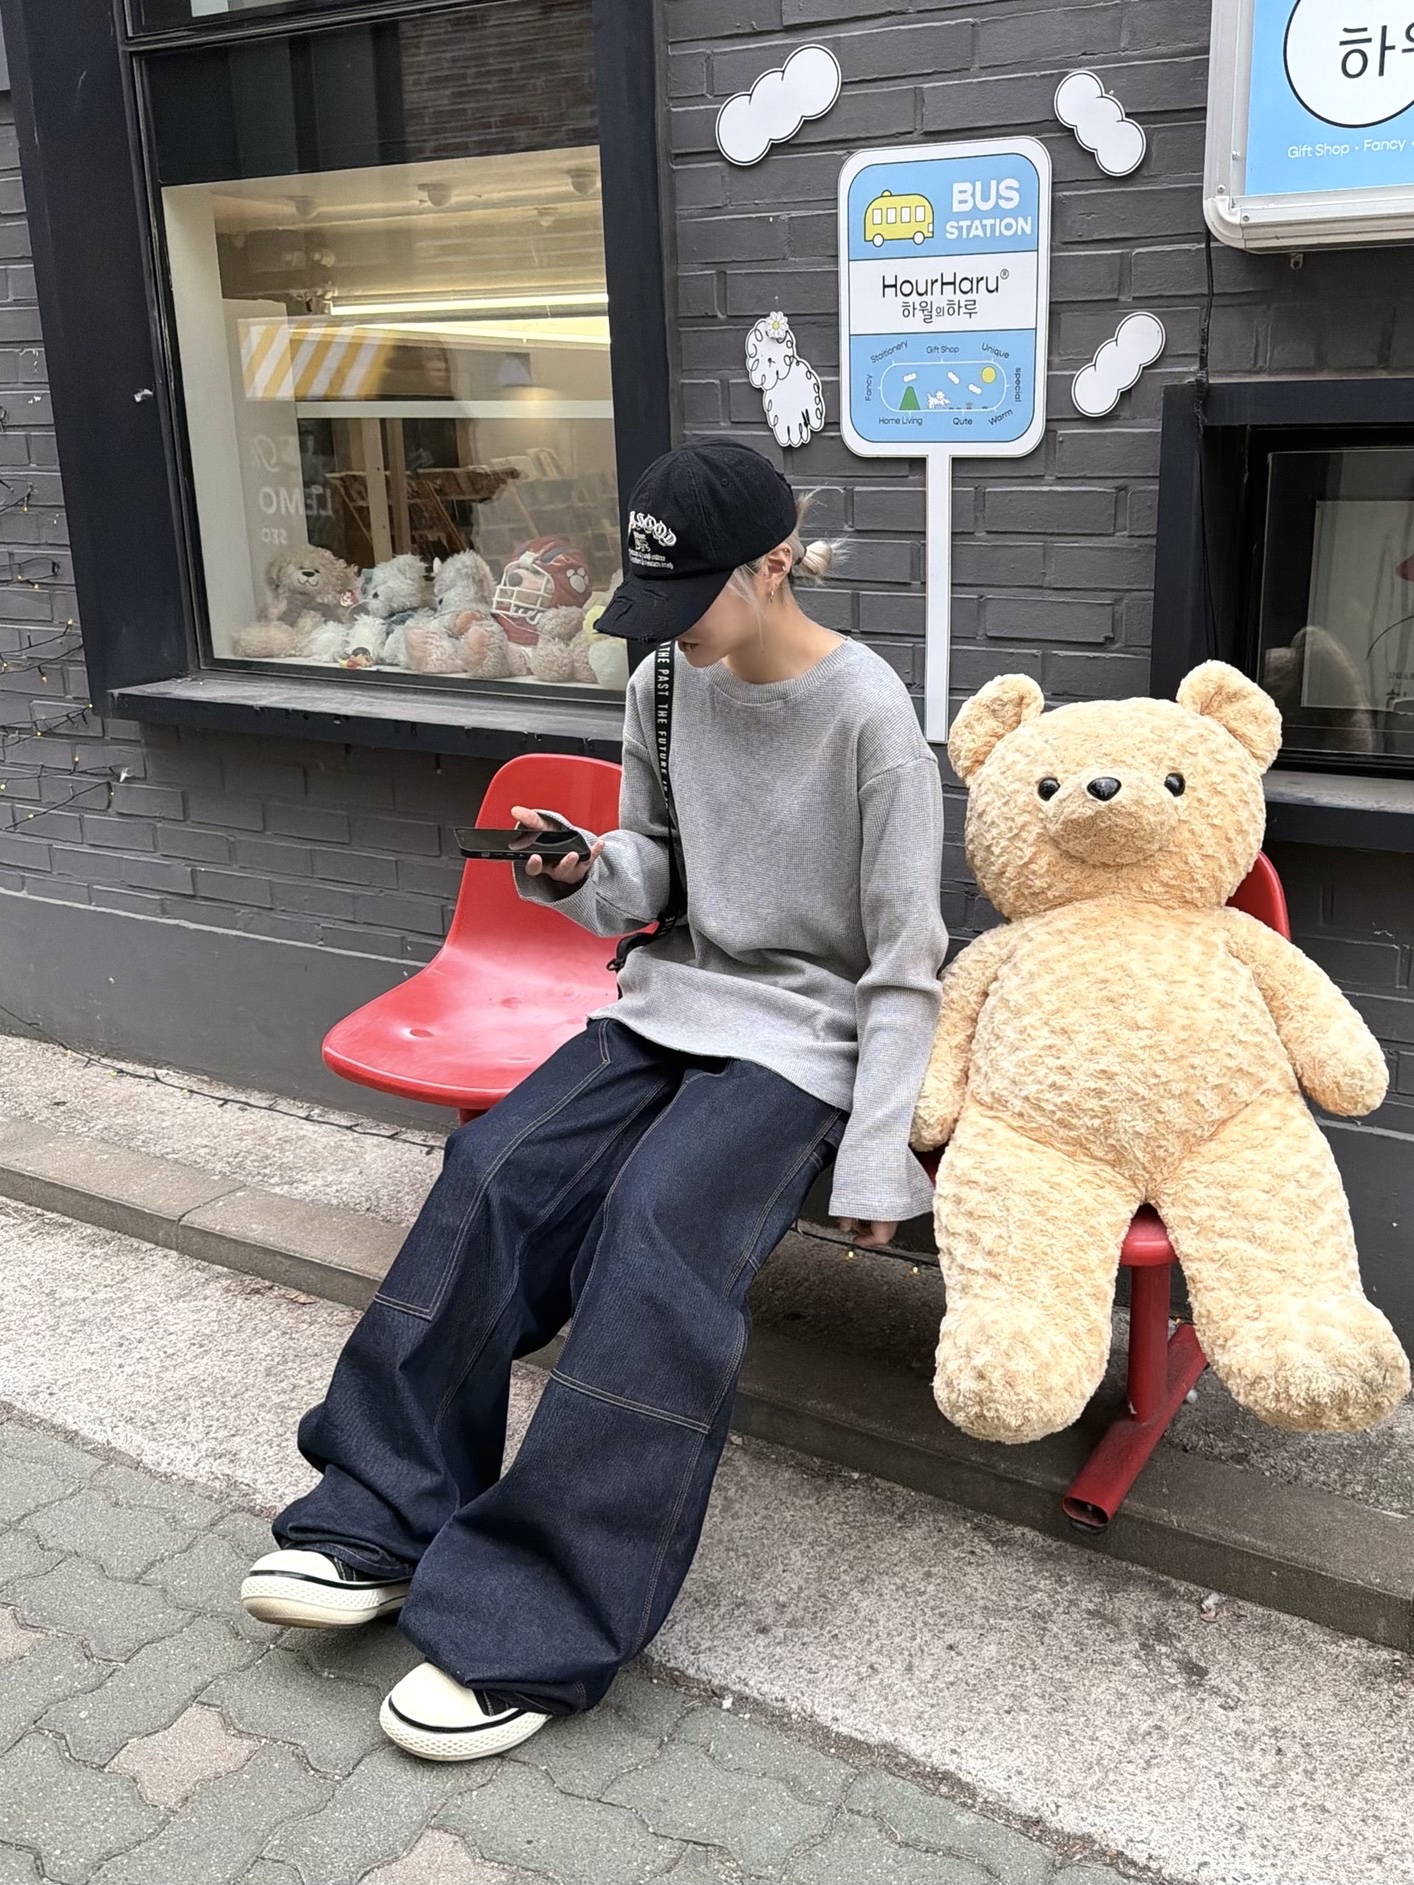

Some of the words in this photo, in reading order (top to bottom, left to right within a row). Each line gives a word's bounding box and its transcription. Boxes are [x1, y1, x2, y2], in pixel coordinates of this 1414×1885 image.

[1287, 143, 1312, 159] Gift
[1315, 142, 1349, 158] Shop
[1363, 137, 1405, 153] Fancy
[952, 177, 1020, 213] BUS
[945, 216, 1031, 240] STATION
[926, 345, 939, 354] Gift
[940, 345, 960, 354] Shop
[981, 342, 1010, 359] Unique
[864, 374, 873, 401] Fancy
[878, 416, 900, 425] Home
[901, 416, 923, 426] Living
[987, 408, 1013, 426] Warm
[657, 647, 670, 663] THE
[657, 668, 667, 695] PAST
[657, 704, 667, 724] THE
[658, 730, 668, 774] FUTURE
